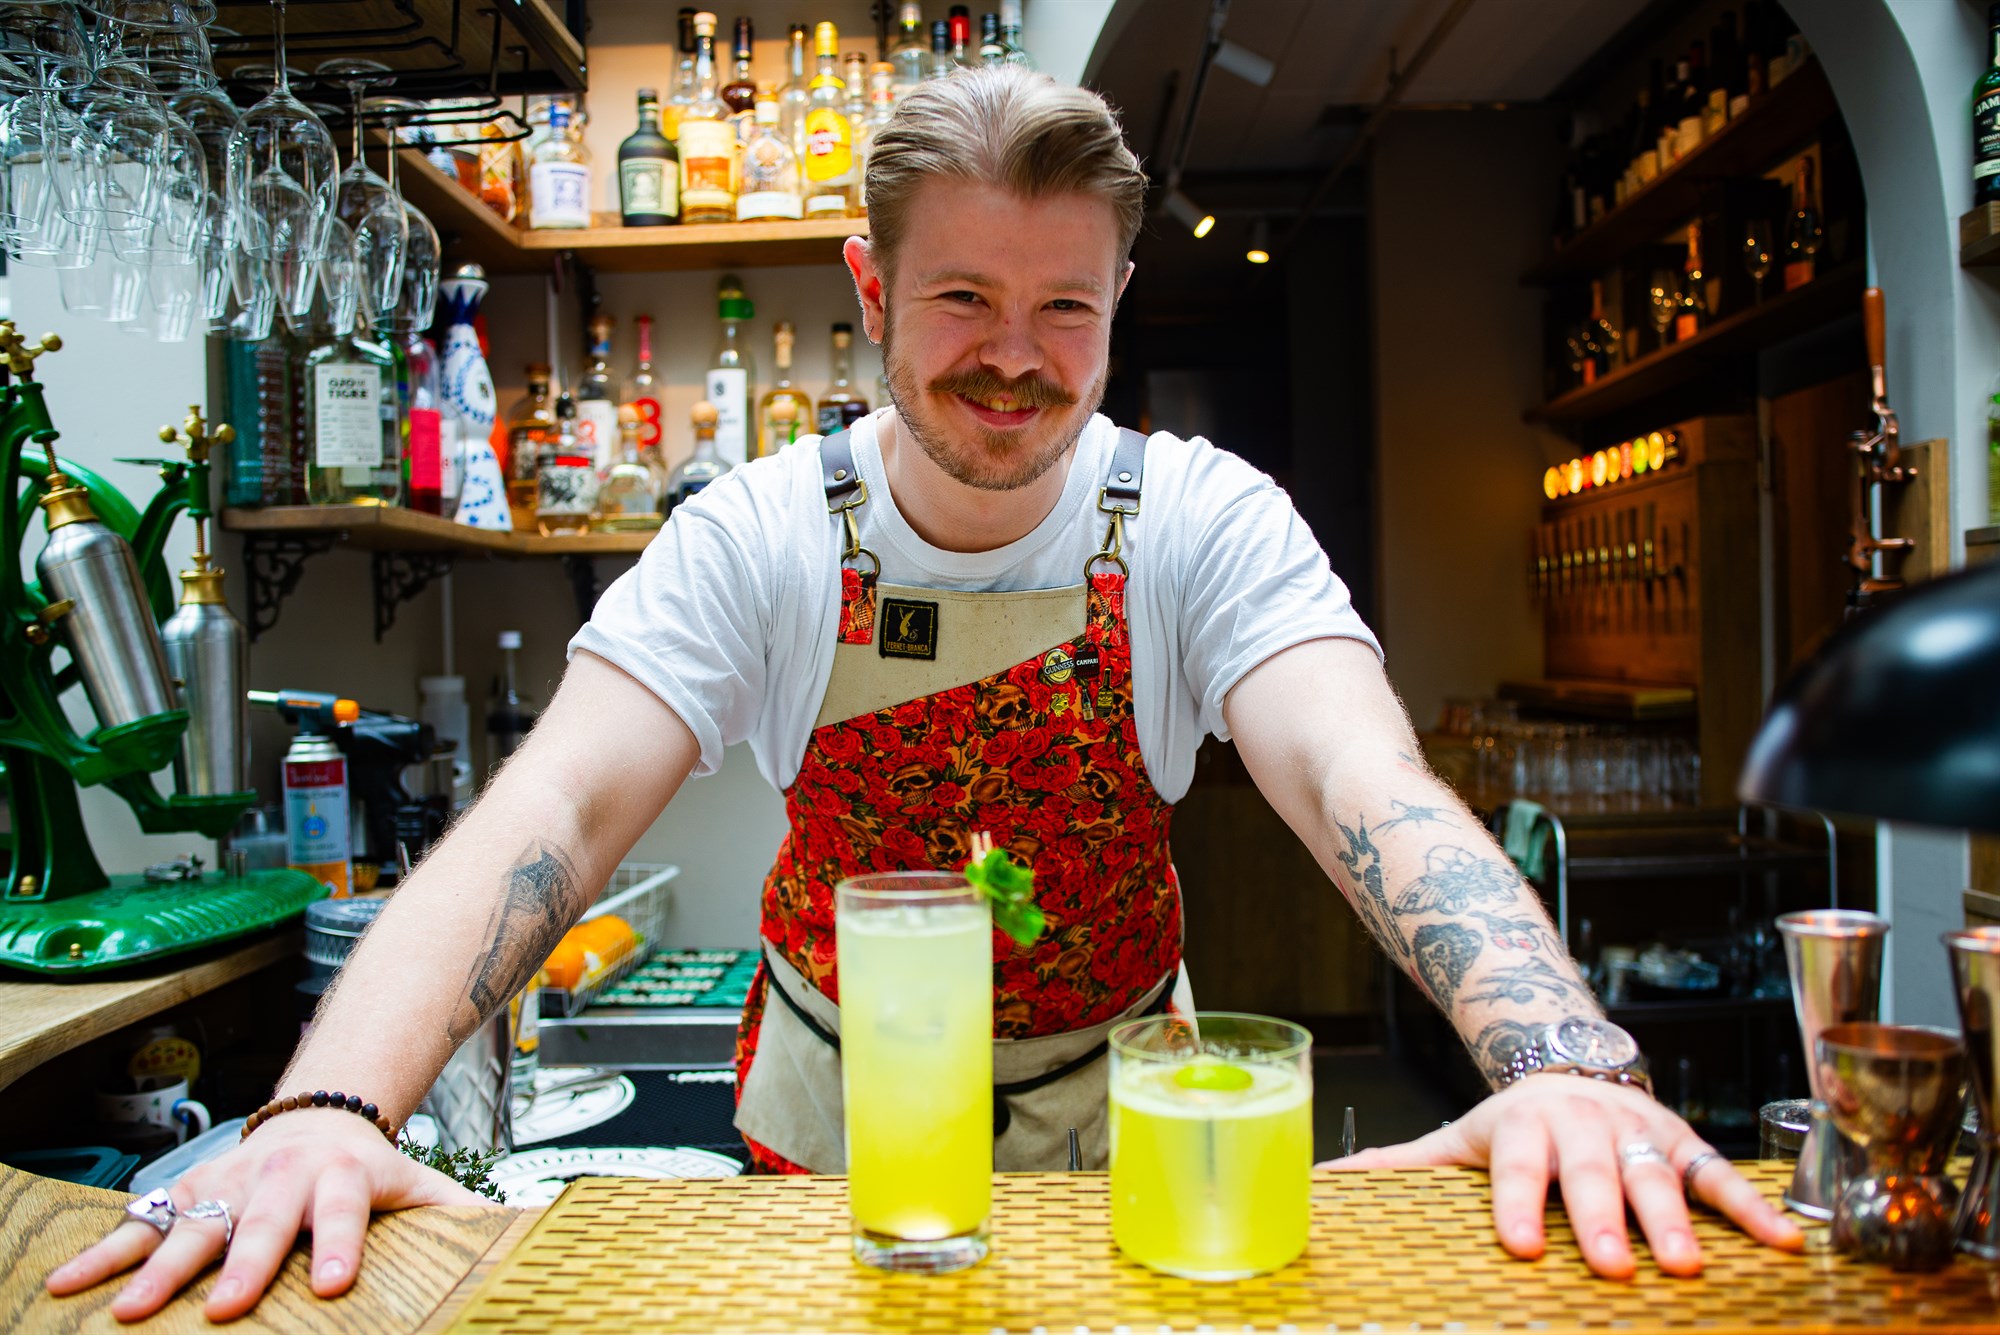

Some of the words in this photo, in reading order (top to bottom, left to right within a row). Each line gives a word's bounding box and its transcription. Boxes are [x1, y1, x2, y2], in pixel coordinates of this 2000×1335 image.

[328, 389, 369, 399] TIGRE
[886, 641, 929, 652] FERNET-BRANCA
[1076, 658, 1099, 666] CAMPARI
[1044, 660, 1075, 675] GUINNESS
